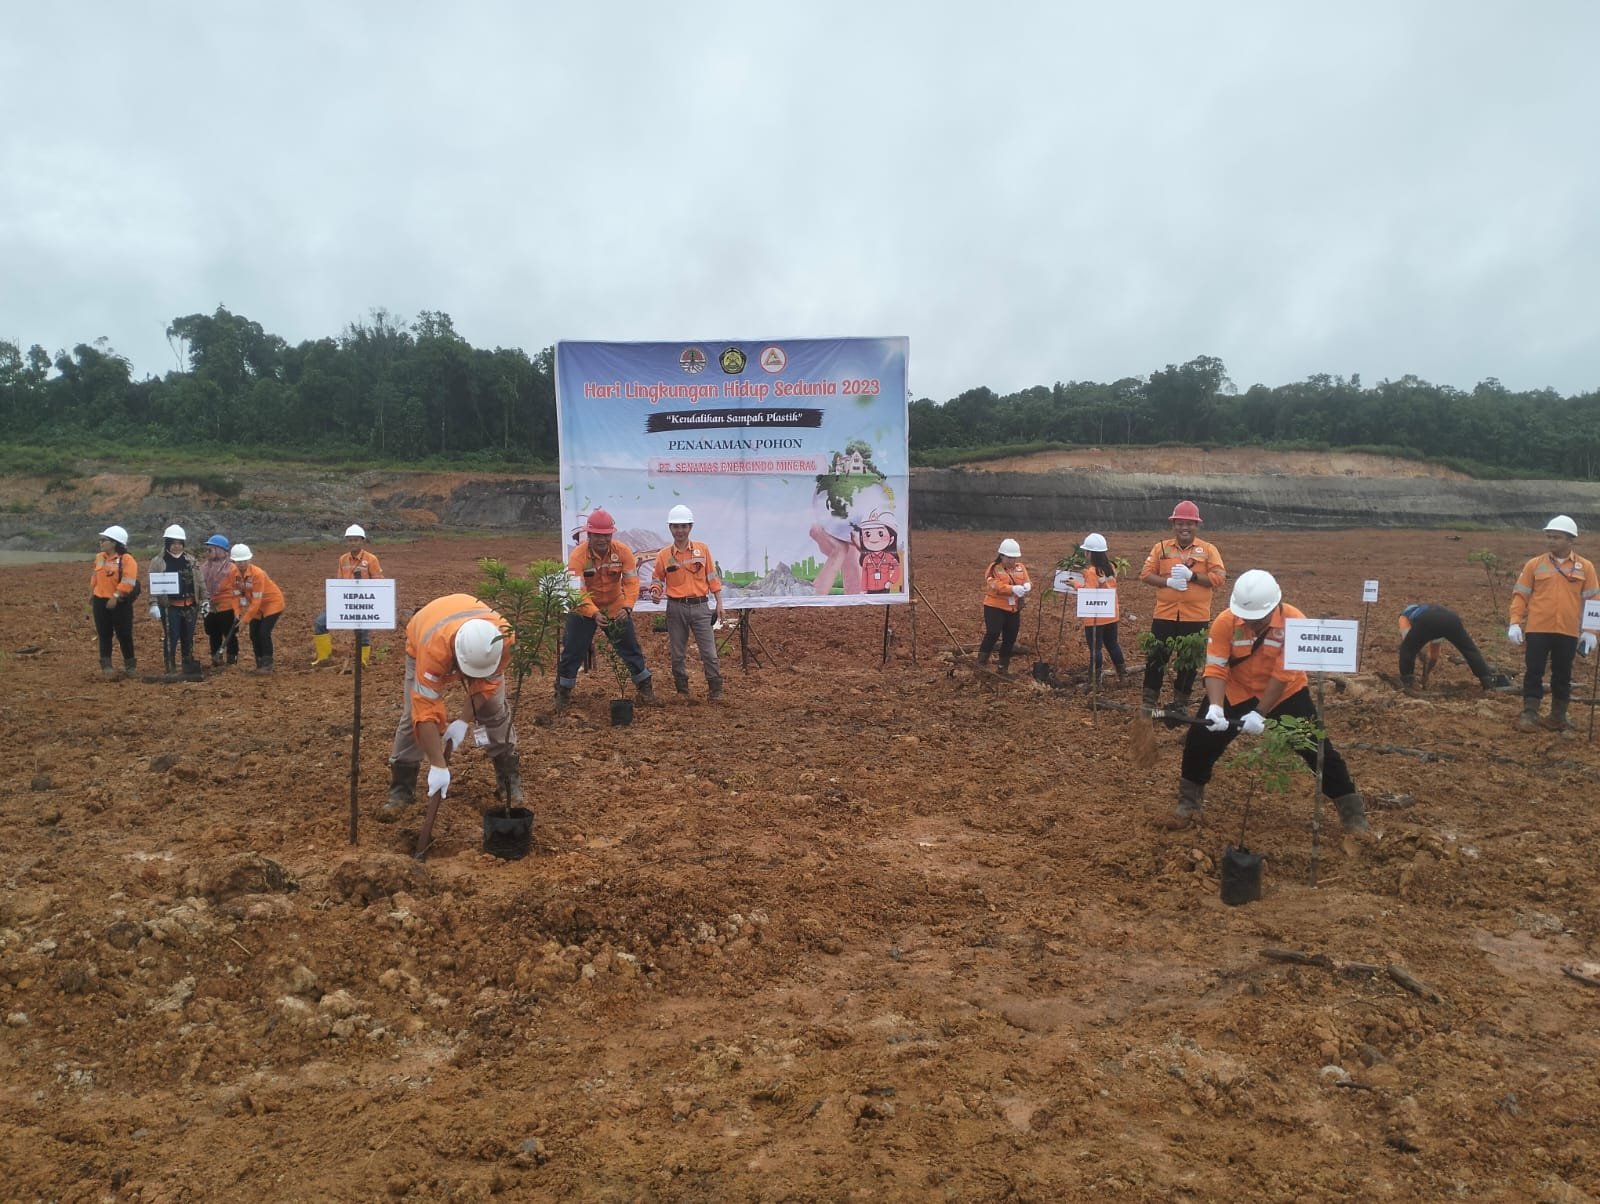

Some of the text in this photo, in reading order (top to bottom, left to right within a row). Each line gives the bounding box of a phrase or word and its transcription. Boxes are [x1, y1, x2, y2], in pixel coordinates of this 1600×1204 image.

[584, 378, 880, 403] Hari Lingkungan Hidup Sedunia 2023
[726, 412, 764, 426] Sampah
[668, 438, 803, 451] PENANAMAN POHON
[343, 592, 376, 600] KEPALA
[1300, 633, 1344, 642] GENERAL
[1297, 645, 1345, 654] MANAGER
